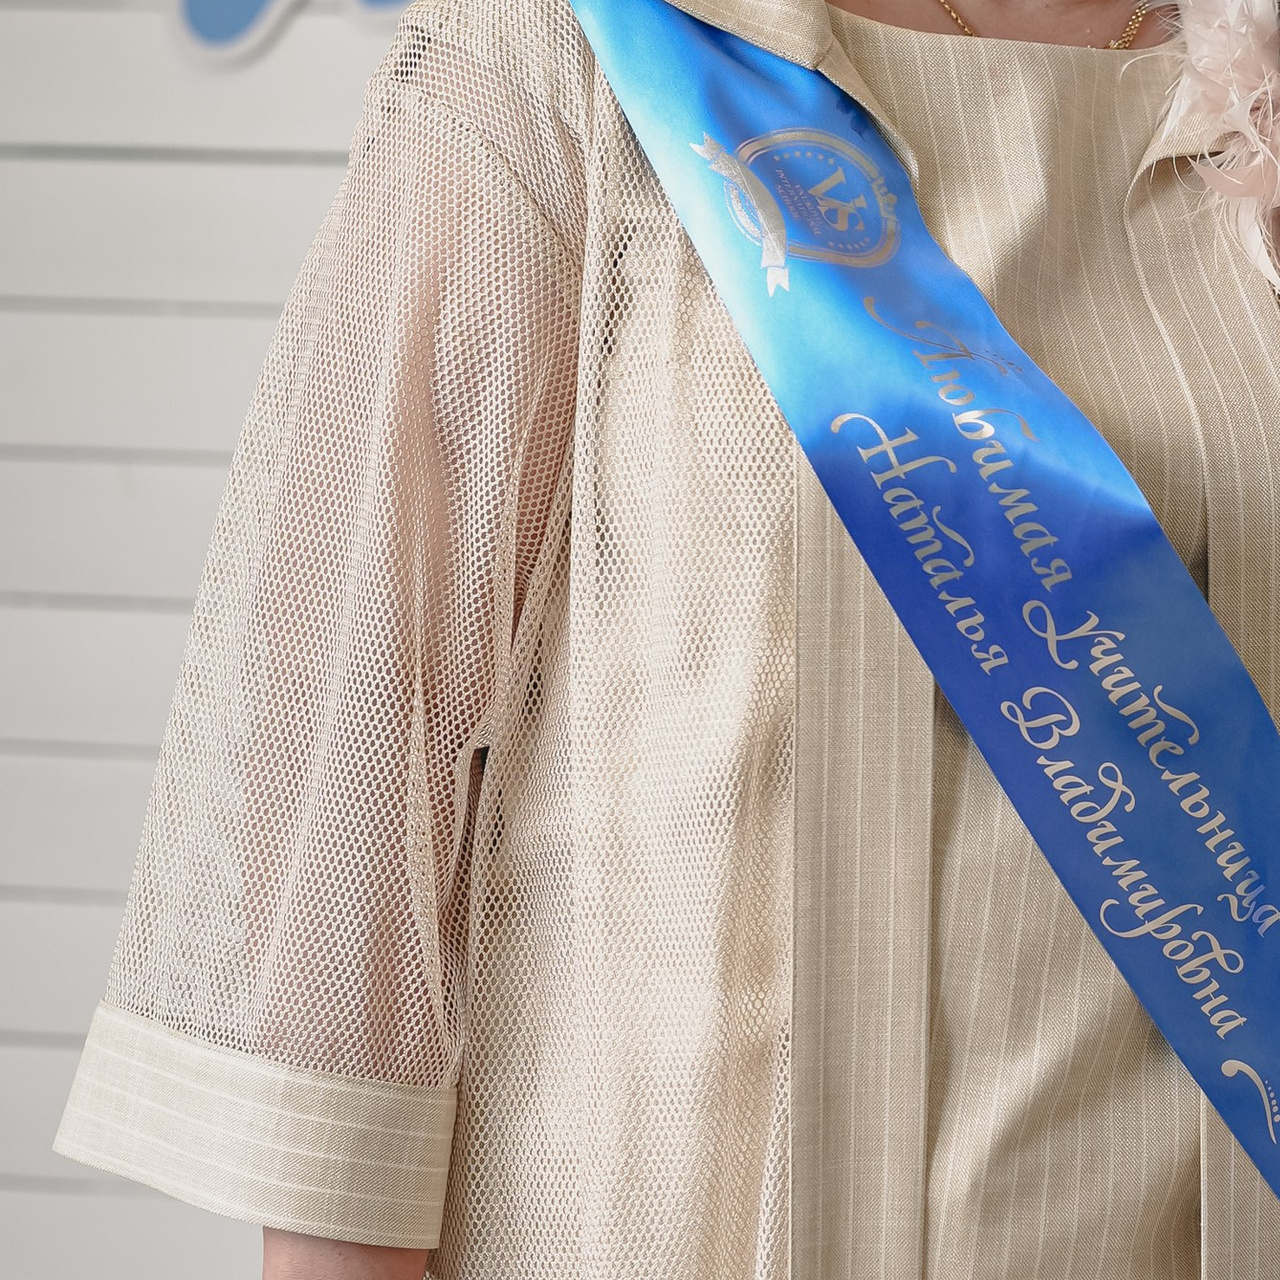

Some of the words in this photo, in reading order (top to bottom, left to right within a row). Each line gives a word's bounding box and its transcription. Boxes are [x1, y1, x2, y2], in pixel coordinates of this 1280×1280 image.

[862, 296, 1074, 594] Любимая
[830, 412, 1010, 677] Наталья
[1000, 685, 1248, 1041] Владимировна
